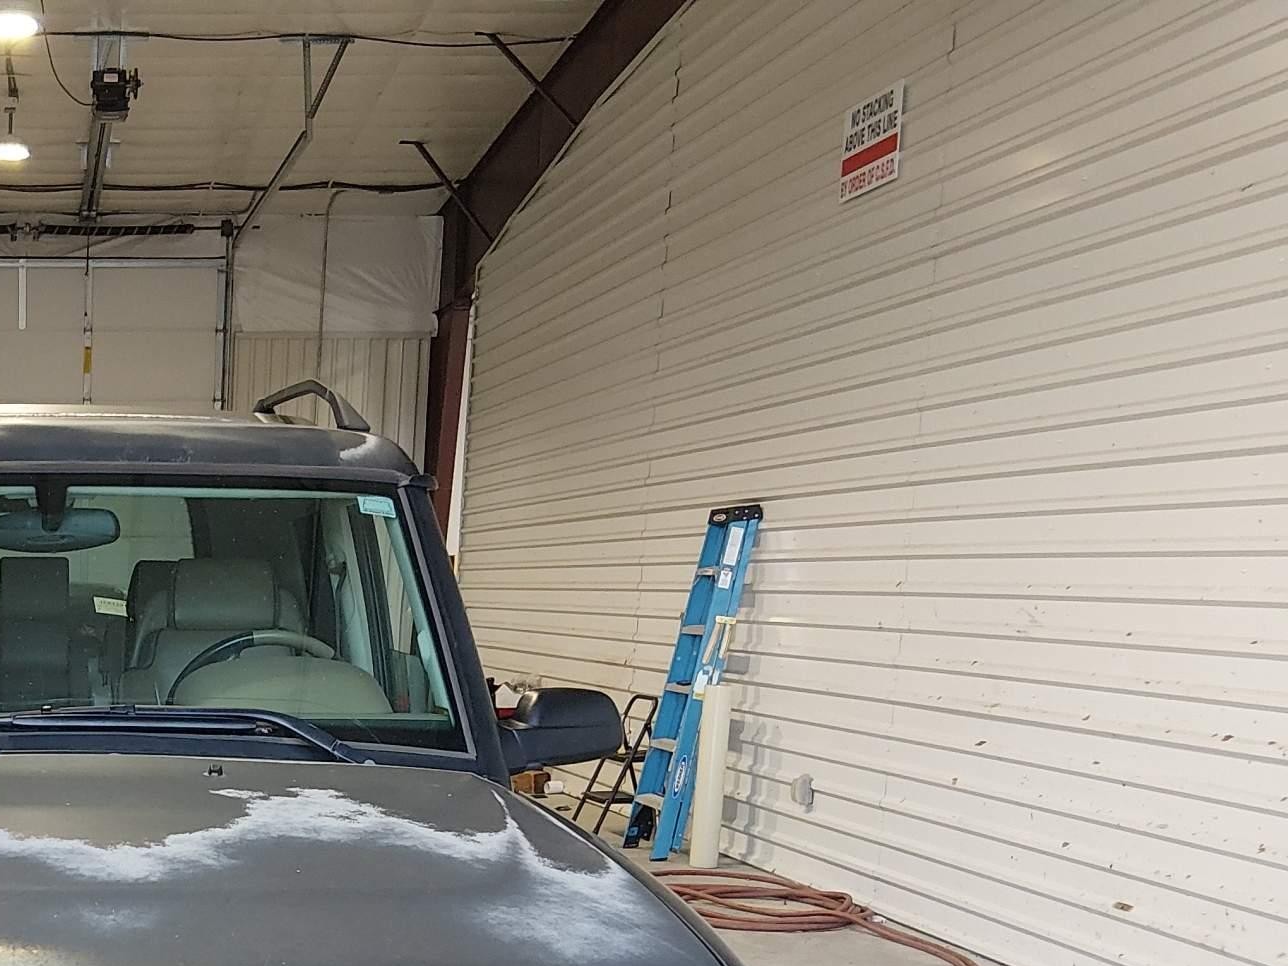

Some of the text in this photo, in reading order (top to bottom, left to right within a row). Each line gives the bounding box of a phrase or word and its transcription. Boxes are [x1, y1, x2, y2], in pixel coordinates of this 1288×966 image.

[851, 90, 894, 129] NO STACKING
[844, 110, 898, 154] ABOVE THIS LINE
[840, 183, 847, 199] BY
[848, 171, 867, 194] ORDER
[867, 167, 875, 186] OF
